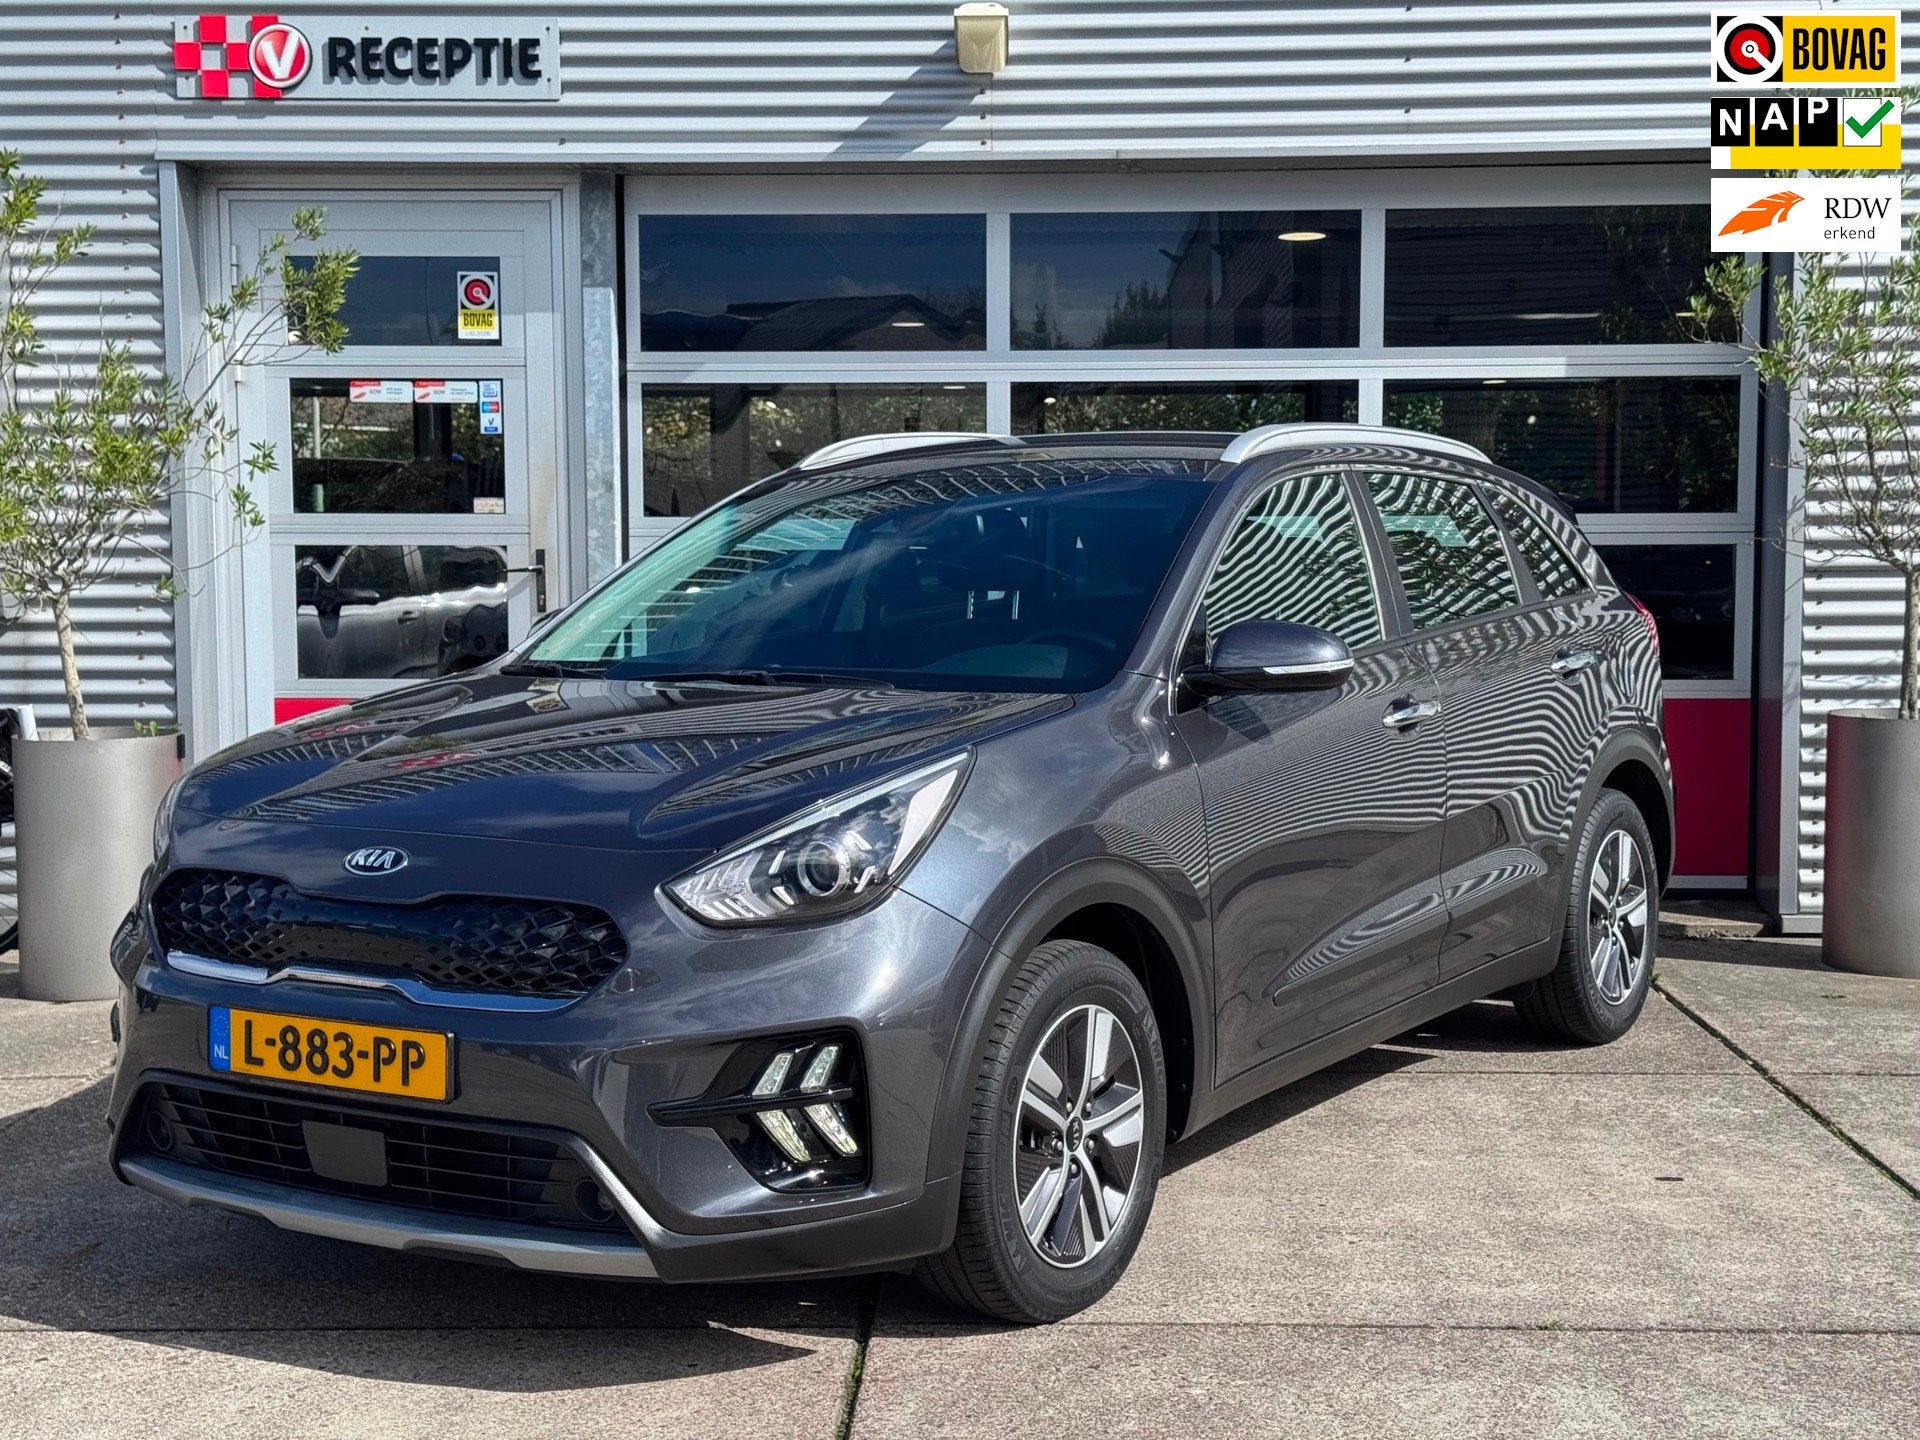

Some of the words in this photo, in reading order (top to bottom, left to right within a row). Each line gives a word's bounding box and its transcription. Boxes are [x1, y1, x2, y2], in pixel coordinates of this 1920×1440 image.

[328, 36, 542, 79] RECEPTIE
[463, 312, 493, 327] BOVAG
[351, 849, 396, 869] KIA
[213, 1043, 229, 1060] NL
[244, 1019, 426, 1087] L-883-PP
[1071, 1121, 1080, 1150] KIA
